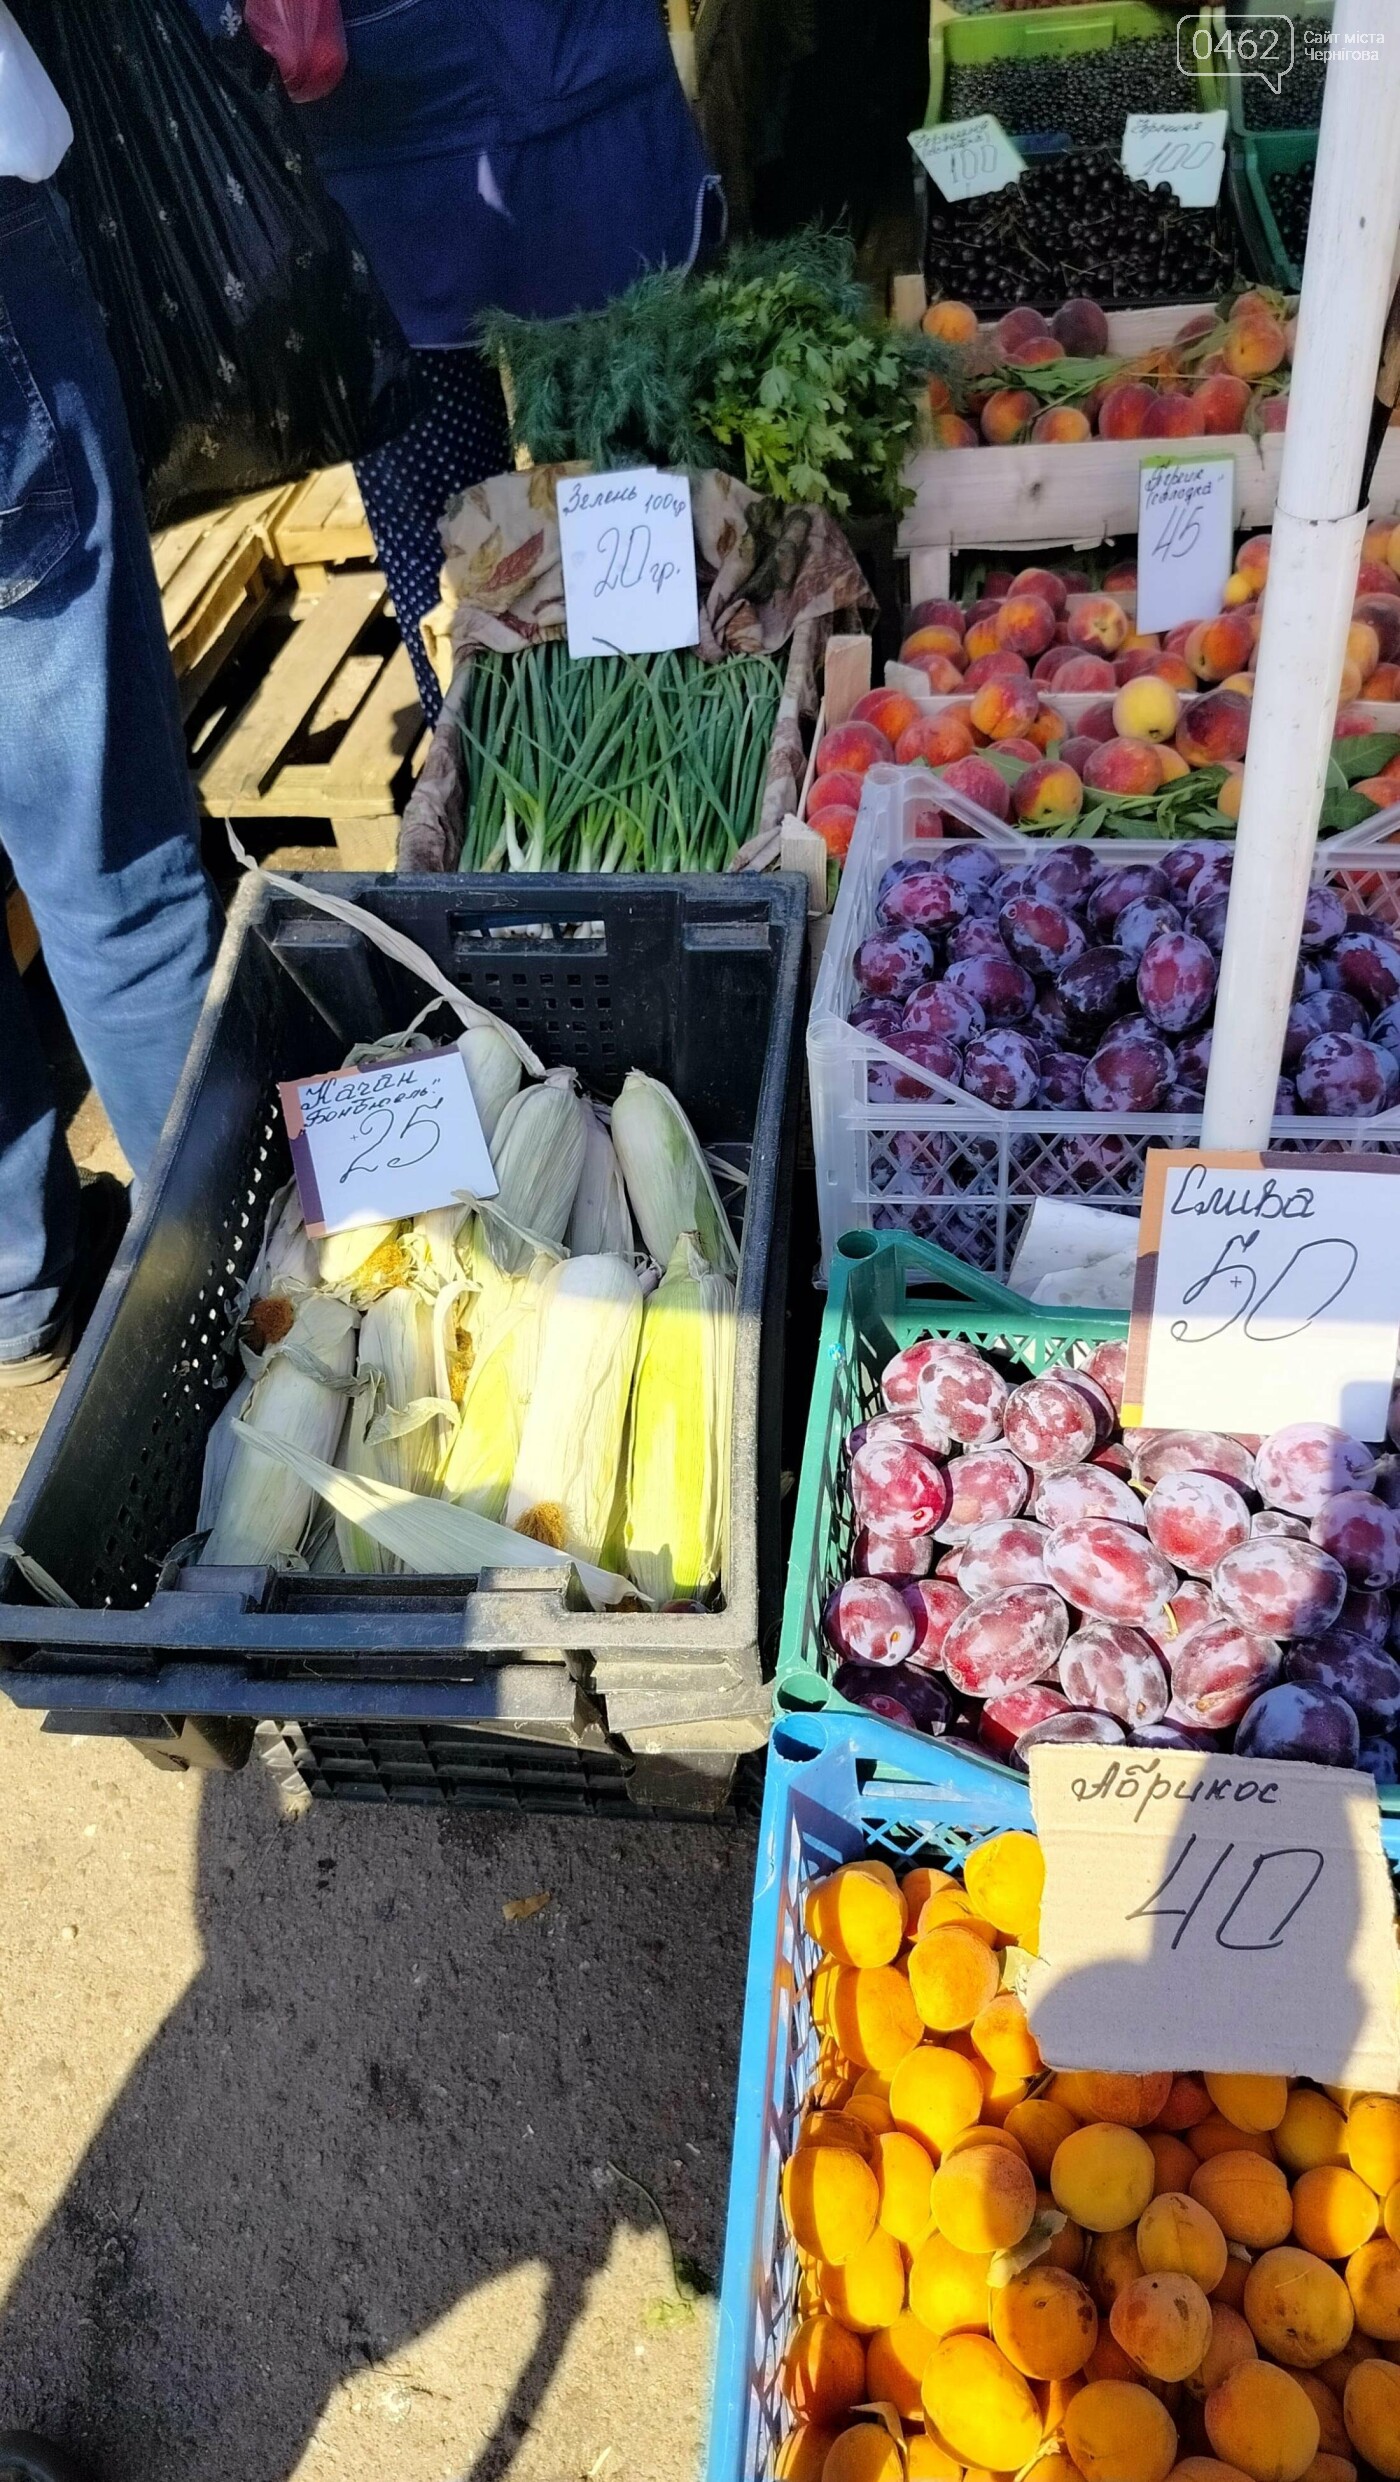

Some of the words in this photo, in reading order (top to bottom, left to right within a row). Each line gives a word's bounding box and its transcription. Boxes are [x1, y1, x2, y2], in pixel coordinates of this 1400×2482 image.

[950, 144, 998, 184] 100
[1137, 141, 1216, 177] 100
[562, 482, 638, 516] Зелень
[645, 492, 687, 518] 100гр
[1151, 505, 1204, 563] 45
[301, 1070, 418, 1110] Качан
[339, 1096, 444, 1184] 25
[1170, 1163, 1316, 1219] Слива
[1170, 1229, 1359, 1343] 50
[1070, 1757, 1280, 1823] Абрикос
[1125, 1832, 1325, 1951] 40
